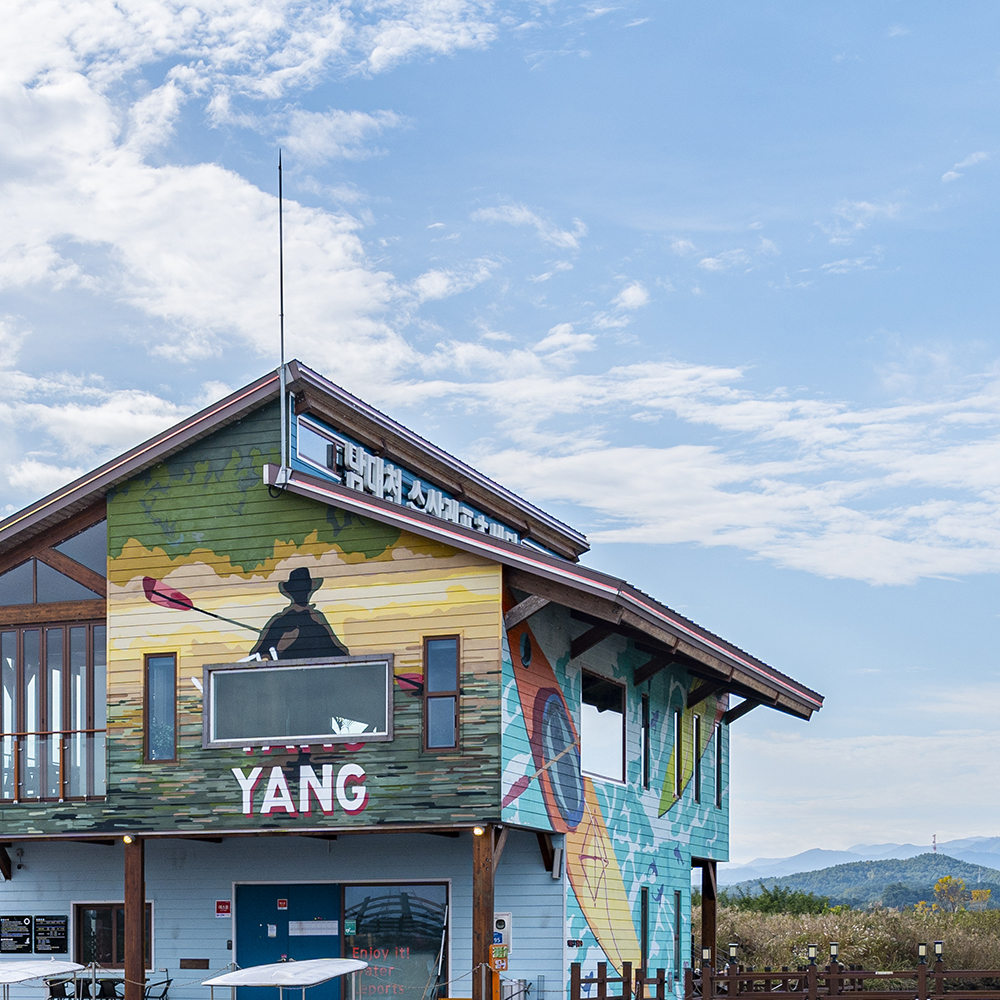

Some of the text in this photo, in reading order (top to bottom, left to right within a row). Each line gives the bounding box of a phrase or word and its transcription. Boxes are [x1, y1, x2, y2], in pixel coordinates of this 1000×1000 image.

[231, 763, 369, 818] YANG
[352, 946, 410, 961] Enjoy it!
